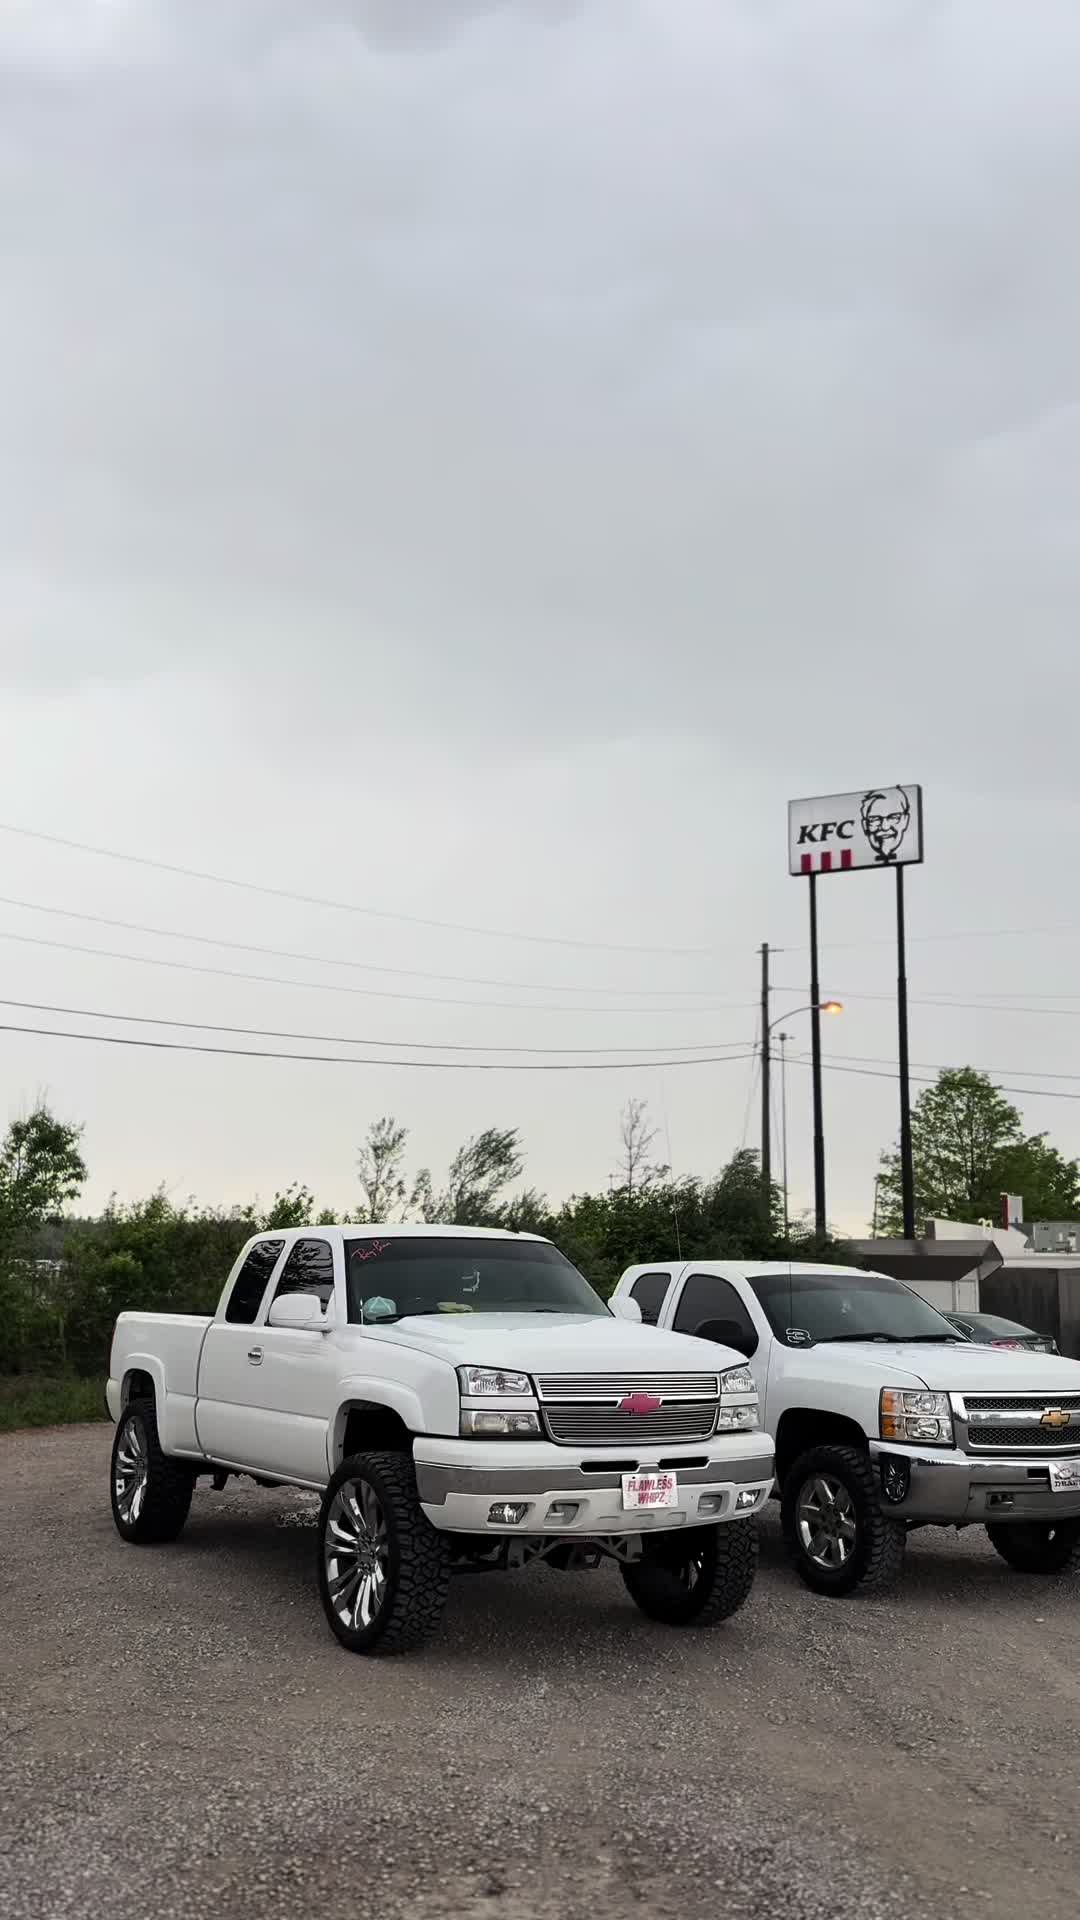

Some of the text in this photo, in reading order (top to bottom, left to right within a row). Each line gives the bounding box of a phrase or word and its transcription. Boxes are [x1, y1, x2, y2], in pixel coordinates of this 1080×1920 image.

[797, 820, 855, 844] KFC
[628, 1478, 673, 1492] FLAWLESS
[638, 1491, 666, 1504] WHIPZ
